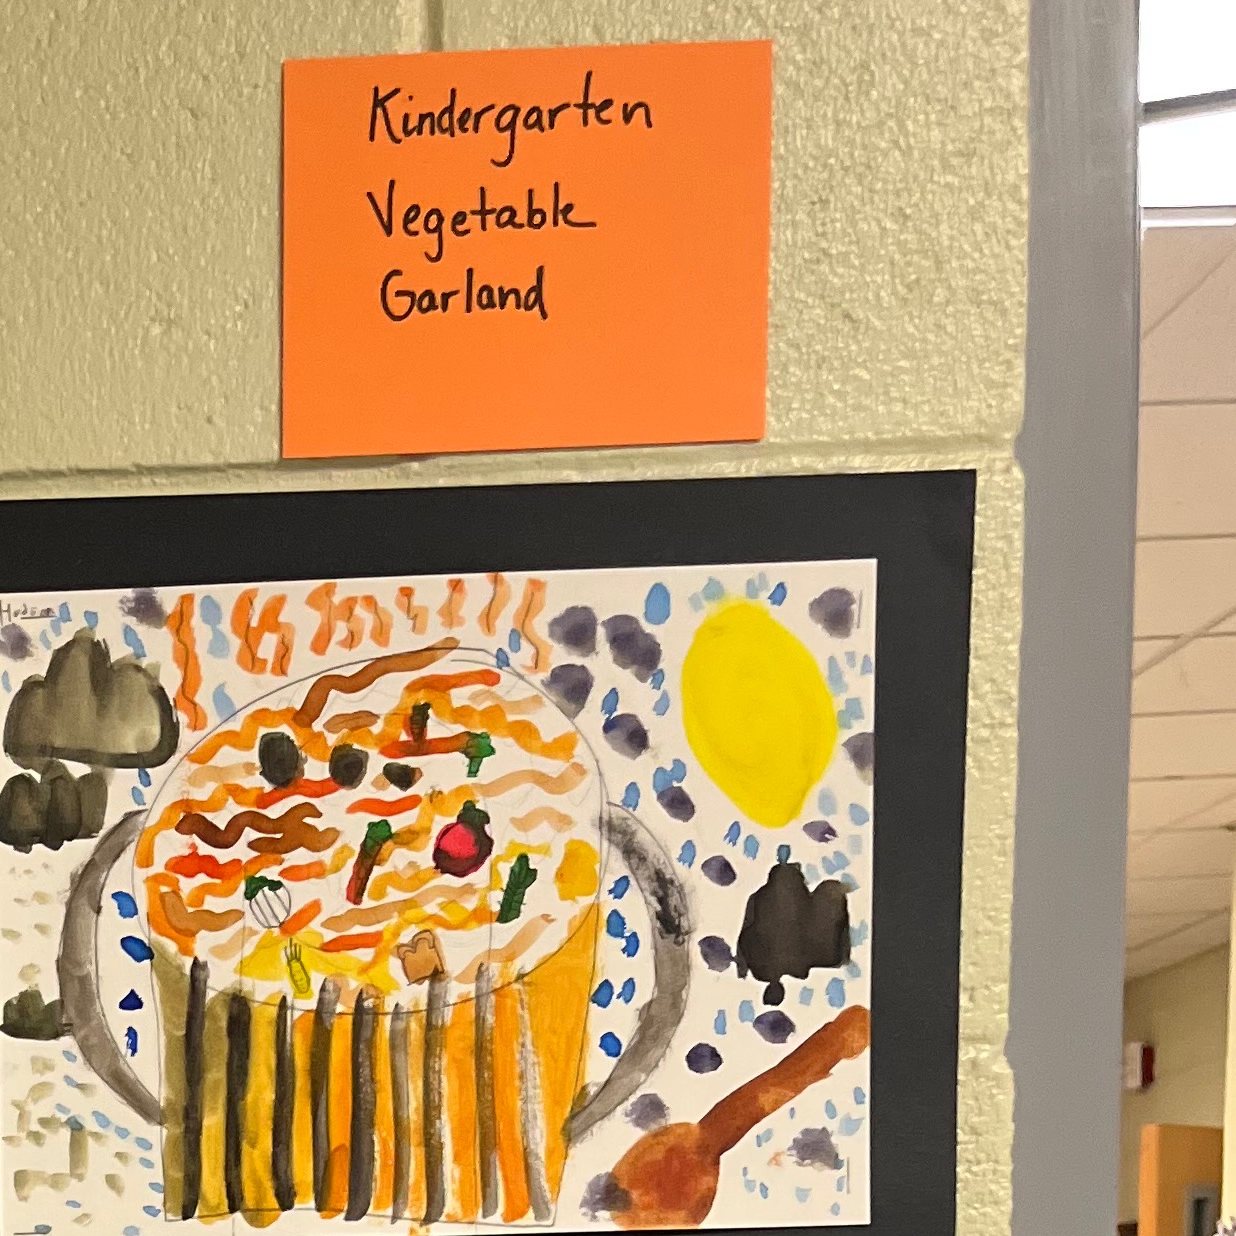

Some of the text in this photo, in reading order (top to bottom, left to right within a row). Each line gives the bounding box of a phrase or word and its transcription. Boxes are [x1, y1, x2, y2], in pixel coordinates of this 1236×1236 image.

[368, 69, 653, 168] Kindergarten
[366, 179, 597, 263] Vegetable
[380, 264, 549, 322] Garland
